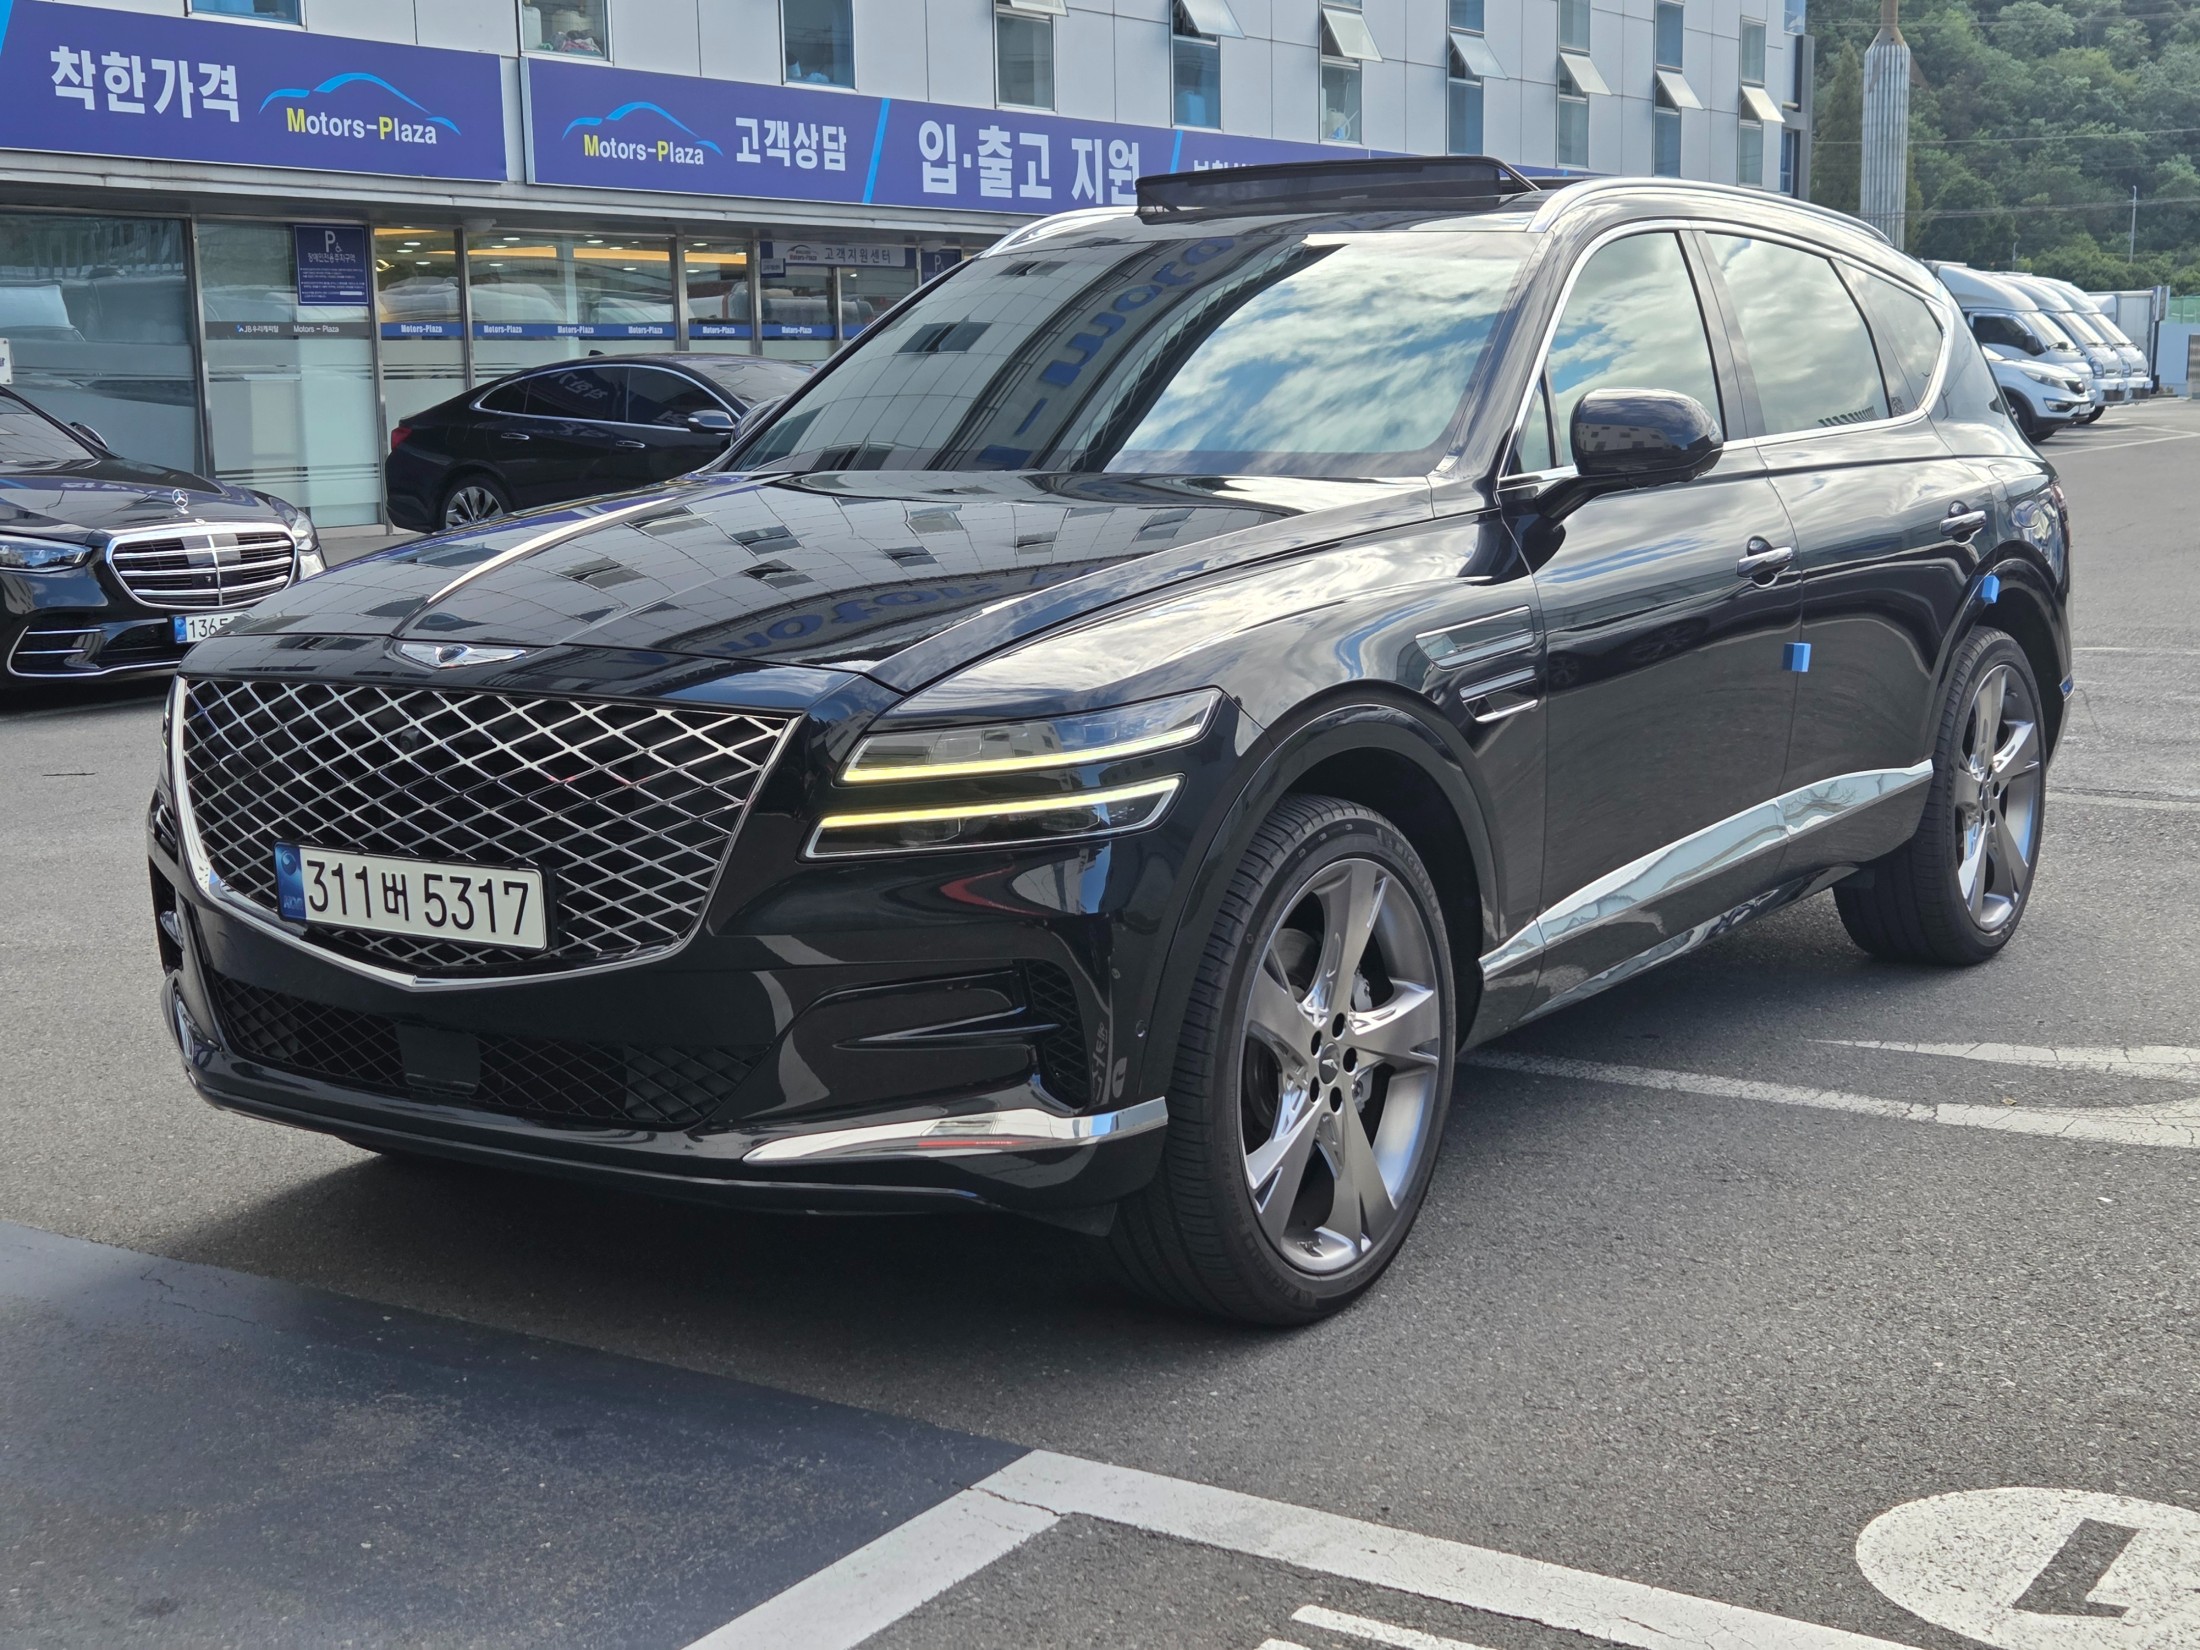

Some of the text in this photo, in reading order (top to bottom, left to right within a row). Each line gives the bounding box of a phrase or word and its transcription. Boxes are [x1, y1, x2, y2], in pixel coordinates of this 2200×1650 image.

[50, 45, 240, 122] 착한가격
[286, 107, 437, 144] Motors-Plaza
[584, 134, 704, 165] Motors-Plaza
[735, 117, 847, 171] 고객상담
[1071, 138, 1140, 205] 지원
[325, 230, 336, 253] P
[824, 247, 891, 264] 고객지원센터
[293, 325, 315, 333] Motors
[322, 325, 340, 333] Plaza
[400, 324, 443, 333] Motors-Plaza
[483, 325, 523, 334] Motors-Plaza
[557, 325, 595, 334] Motors-Plaza
[628, 325, 663, 334] Motors-Plaza
[307, 859, 528, 935] 311버 5317
